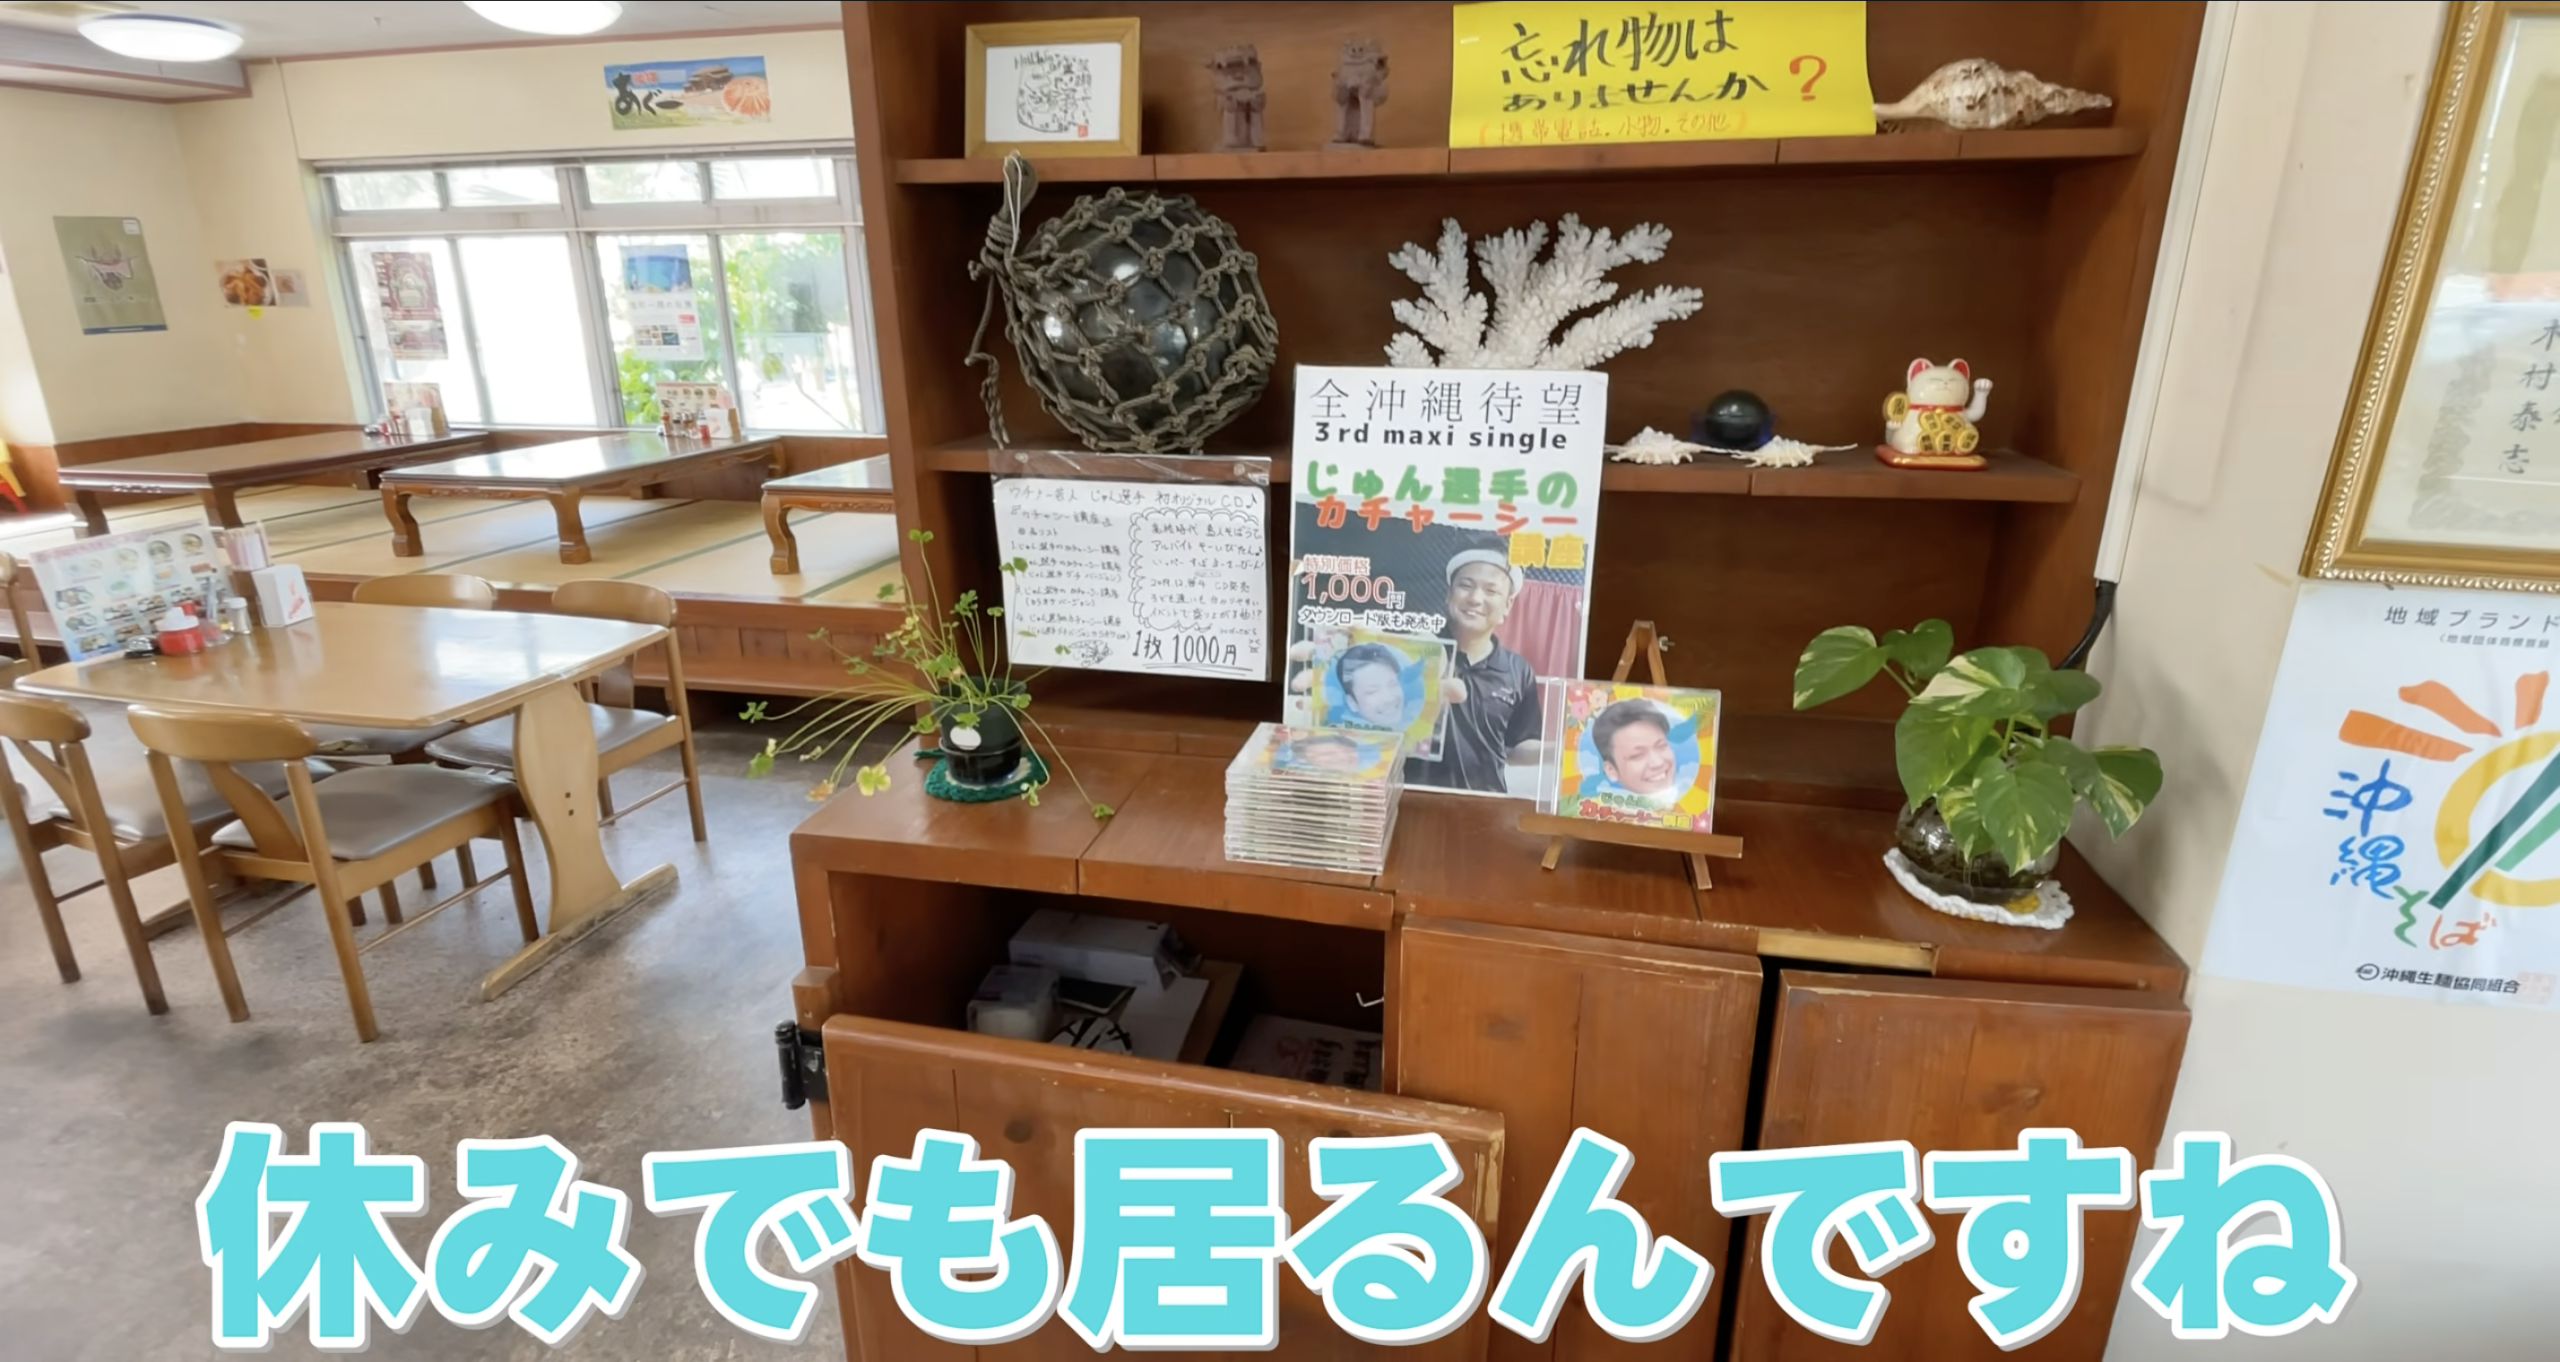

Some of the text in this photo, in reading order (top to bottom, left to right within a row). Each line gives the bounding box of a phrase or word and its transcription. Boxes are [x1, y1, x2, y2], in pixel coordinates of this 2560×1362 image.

[1501, 9, 1739, 84] 忘れ物は
[1503, 72, 1769, 112] ありませんか
[1310, 378, 1582, 425] 全沖縄待望
[1315, 422, 1567, 453] 3rd maxi single
[1307, 460, 1577, 508] じゅん選手の
[1316, 495, 1578, 535] カチャーシー
[1303, 555, 1370, 576] 特別価格
[1508, 532, 1585, 568] 講座
[1300, 573, 1405, 610] 1,000円
[1172, 633, 1238, 666] 1000円
